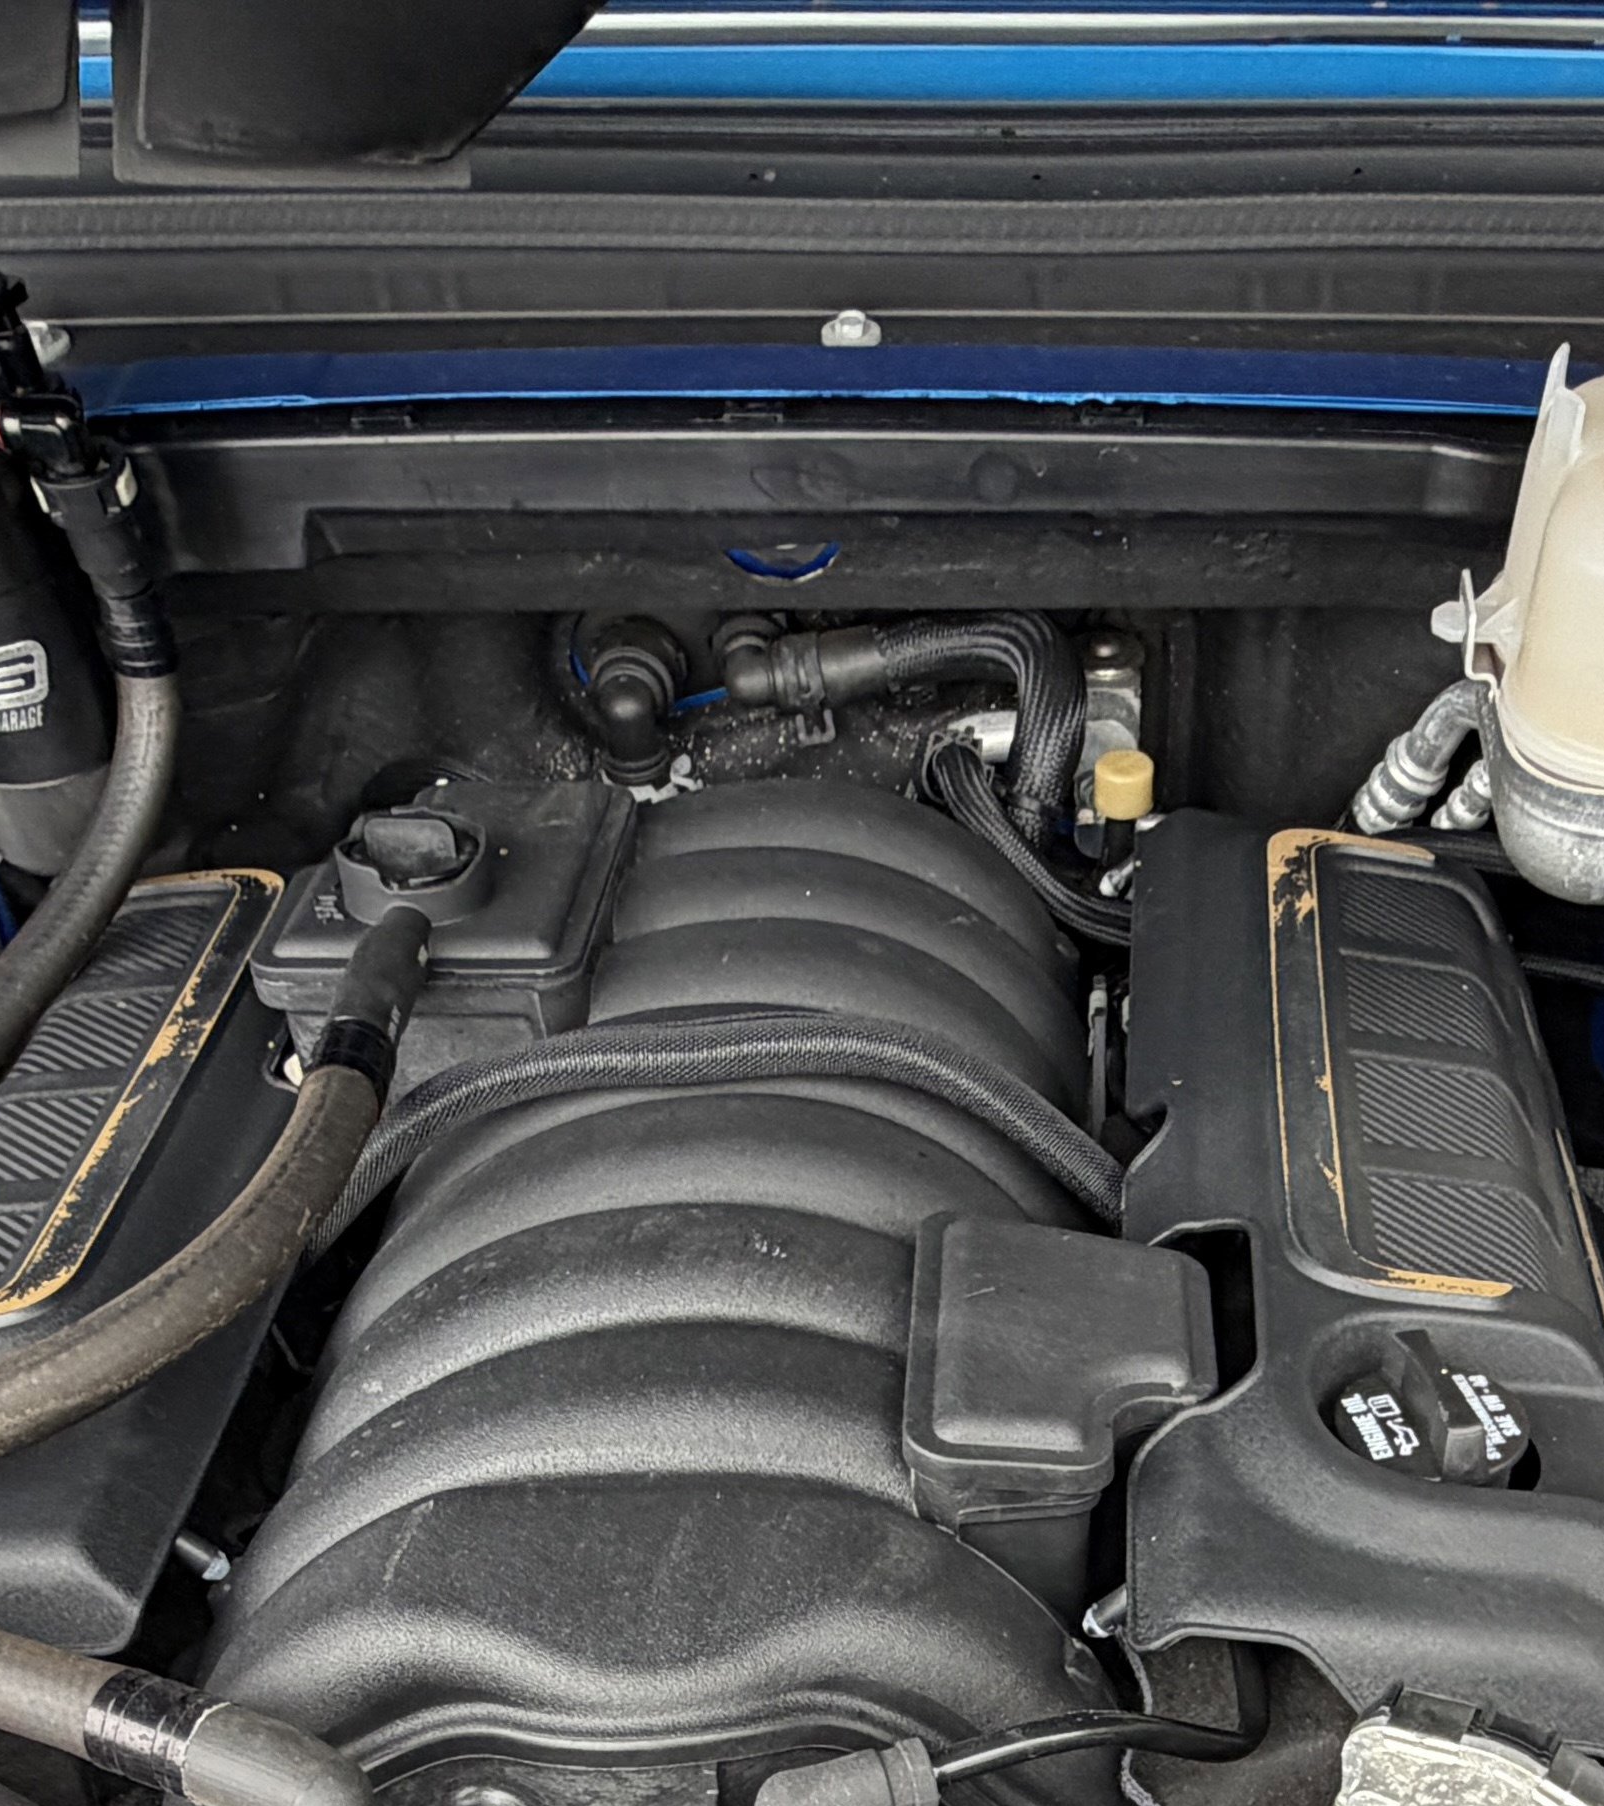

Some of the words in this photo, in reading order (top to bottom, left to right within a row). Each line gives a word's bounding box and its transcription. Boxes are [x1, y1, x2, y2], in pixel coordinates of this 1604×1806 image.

[1341, 1393, 1368, 1414] OIL
[1352, 1412, 1394, 1460] ENGINE
[1494, 1413, 1522, 1437] SAE
